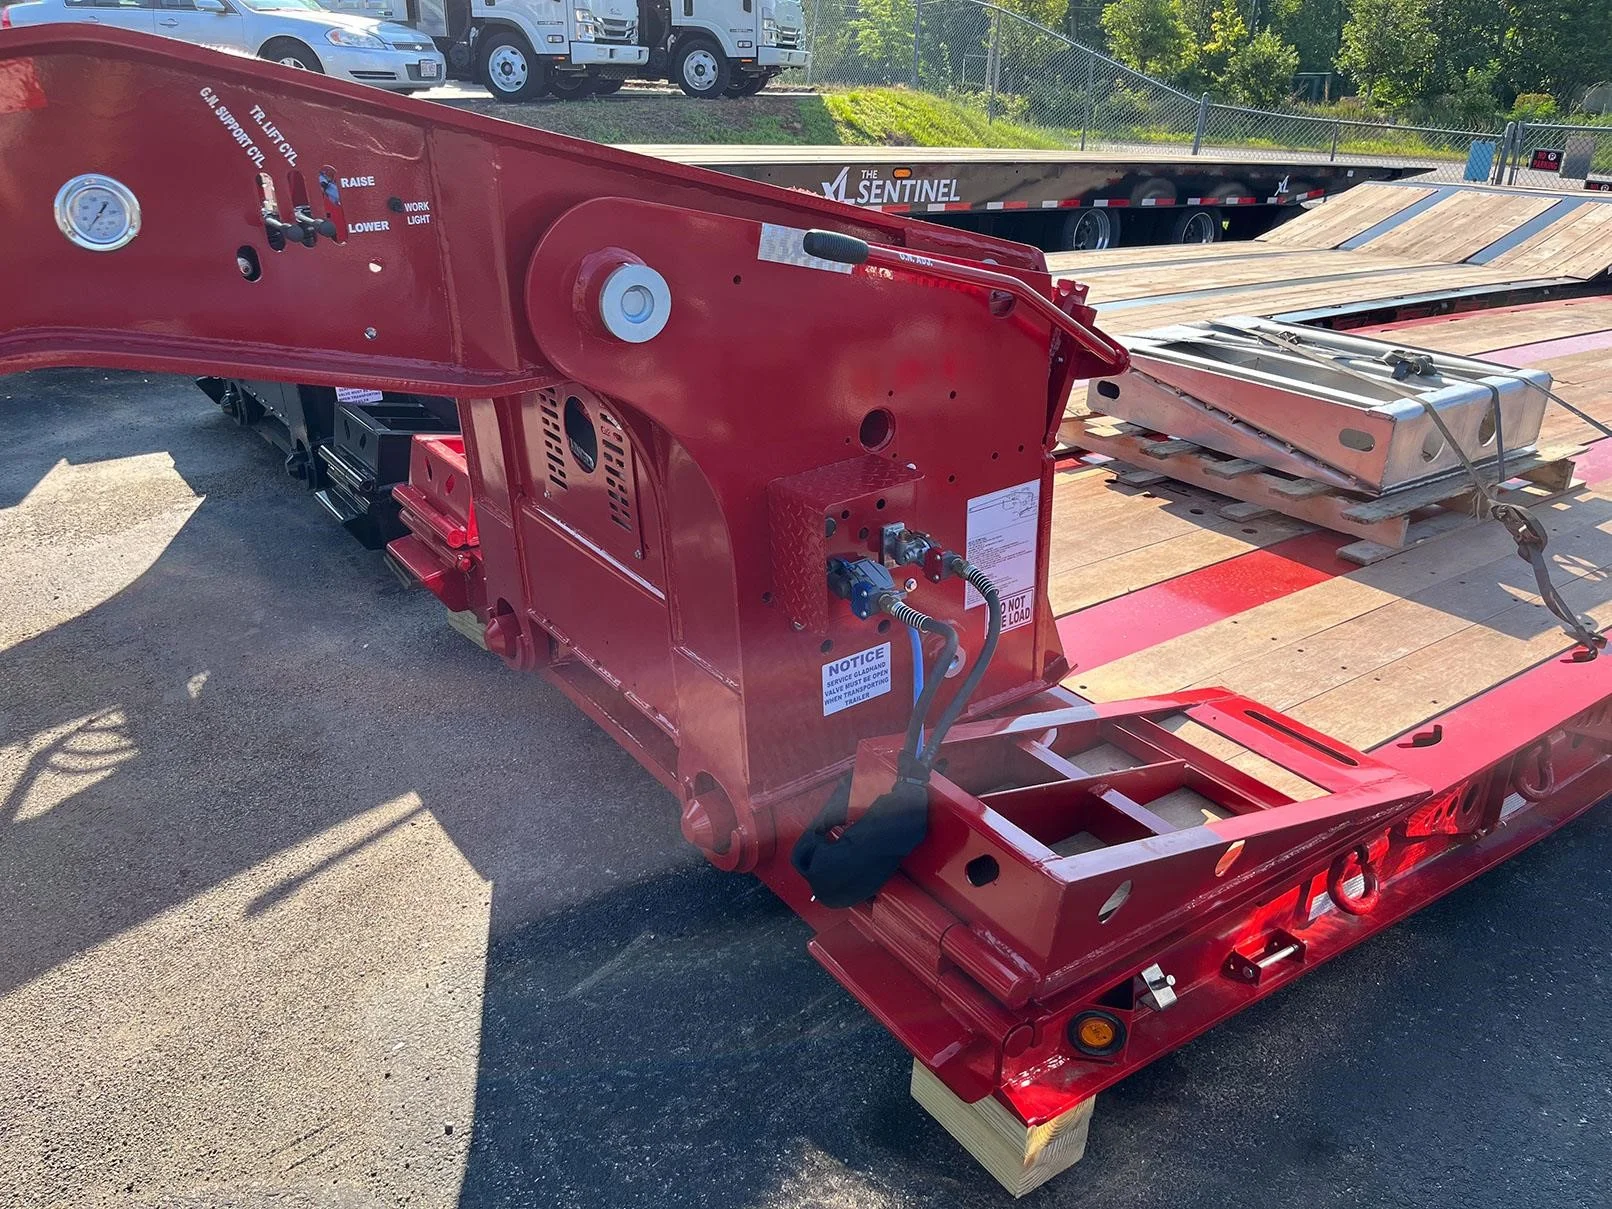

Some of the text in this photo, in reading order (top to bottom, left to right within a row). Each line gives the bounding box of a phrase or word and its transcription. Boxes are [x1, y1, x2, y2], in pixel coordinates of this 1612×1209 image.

[200, 87, 265, 168] G.N. SUPPORT CYL.
[250, 104, 298, 167] TR. LIFT CYL.
[1533, 160, 1558, 170] PARKING
[340, 176, 375, 188] RAISE
[861, 170, 878, 179] THE
[856, 179, 960, 204] SENTINEL
[404, 201, 430, 212] WORK
[348, 220, 390, 233] LOWER
[407, 214, 430, 225] LIGHT
[1008, 595, 1026, 612] NOT
[1009, 608, 1031, 625] LOAD
[828, 647, 884, 677] NOTICE
[824, 685, 844, 697] VALVE
[845, 679, 862, 690] MUST
[872, 668, 888, 679] OPEN
[826, 661, 886, 688] SERVICE GLADHAND
[824, 677, 889, 706] WHEN TRANSPORTING
[845, 692, 870, 706] TRAILER
